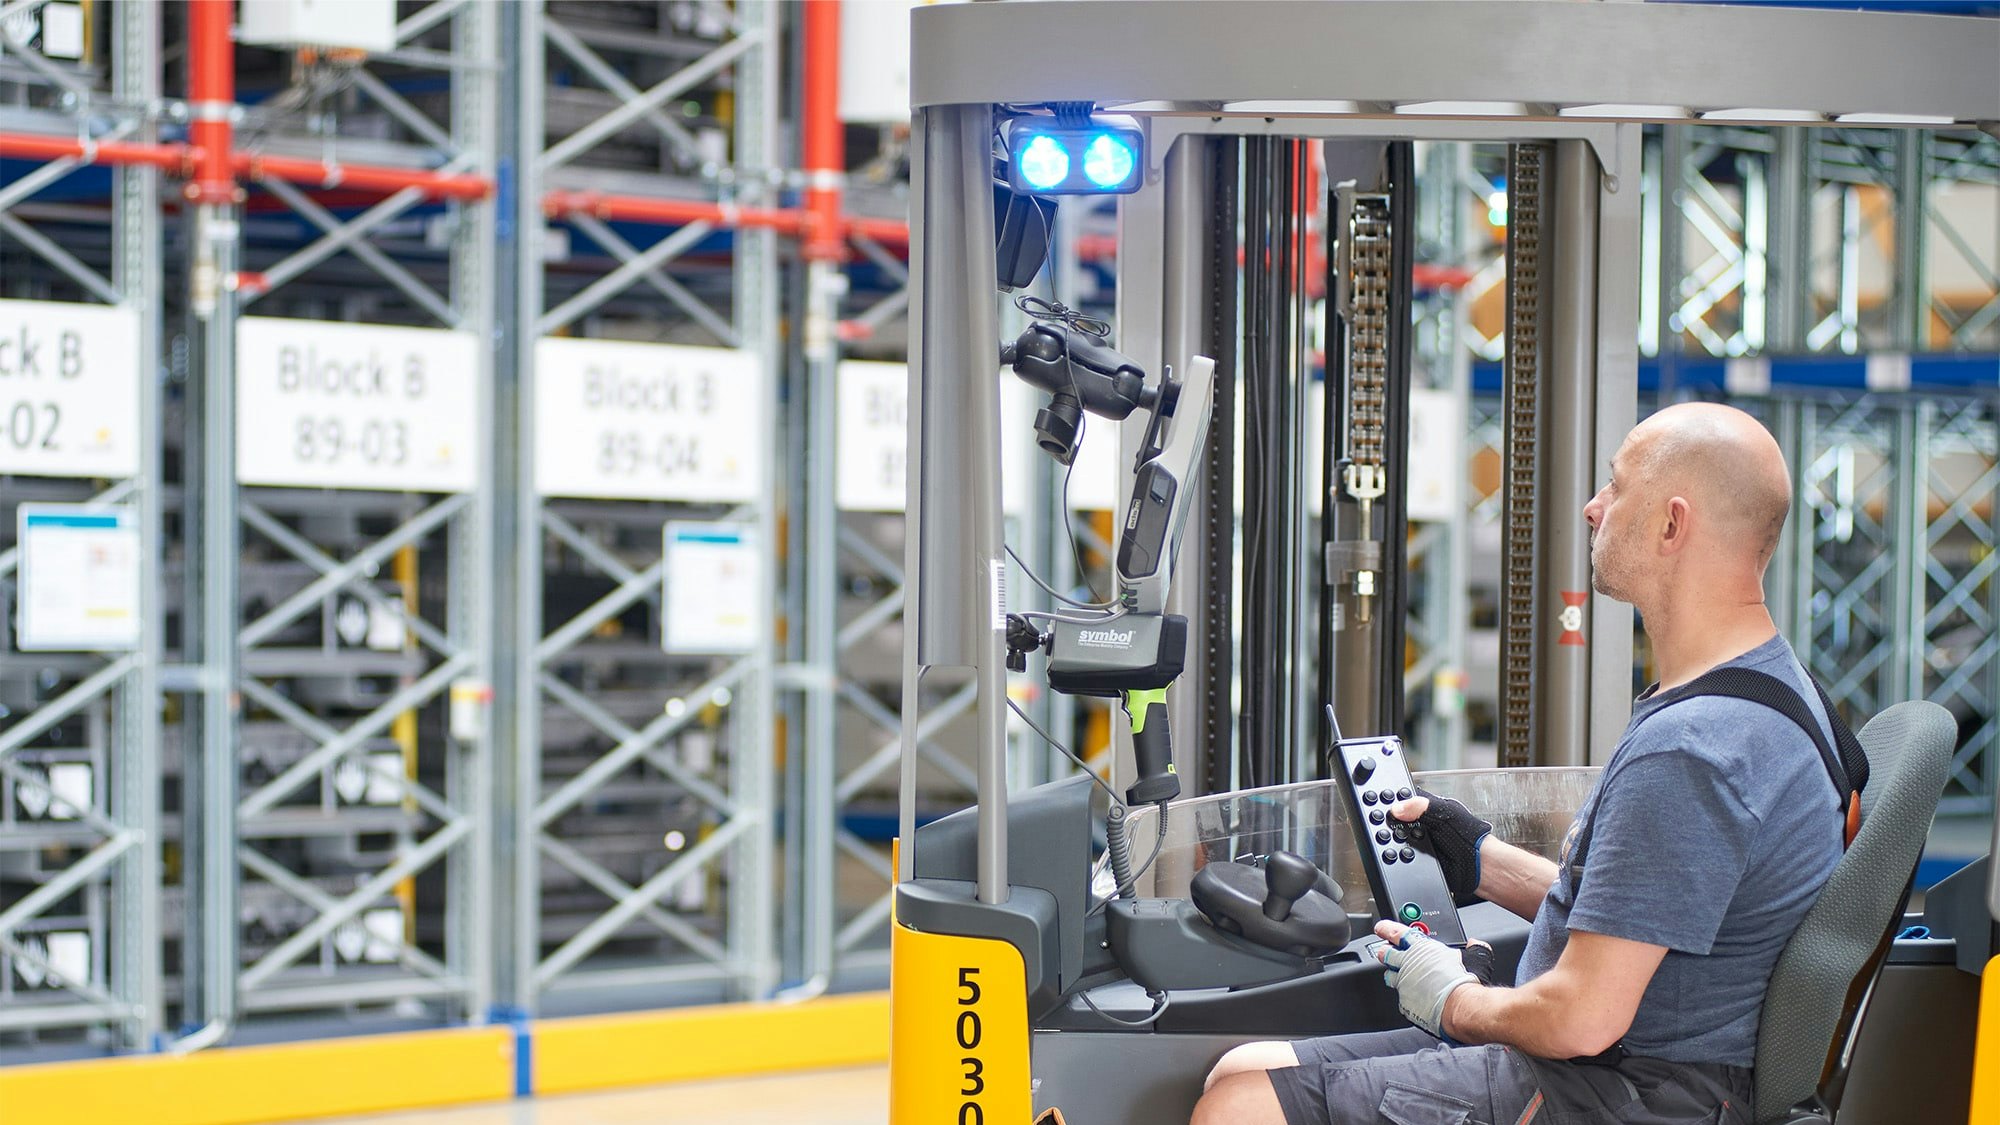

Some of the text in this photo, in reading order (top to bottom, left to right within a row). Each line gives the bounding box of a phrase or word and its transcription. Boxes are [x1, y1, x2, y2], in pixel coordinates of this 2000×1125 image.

[58, 328, 85, 380] B
[277, 345, 428, 401] Block B
[584, 363, 715, 416] Block B
[294, 414, 410, 468] 89-03
[598, 430, 701, 478] 89-04
[1079, 629, 1133, 642] symbol
